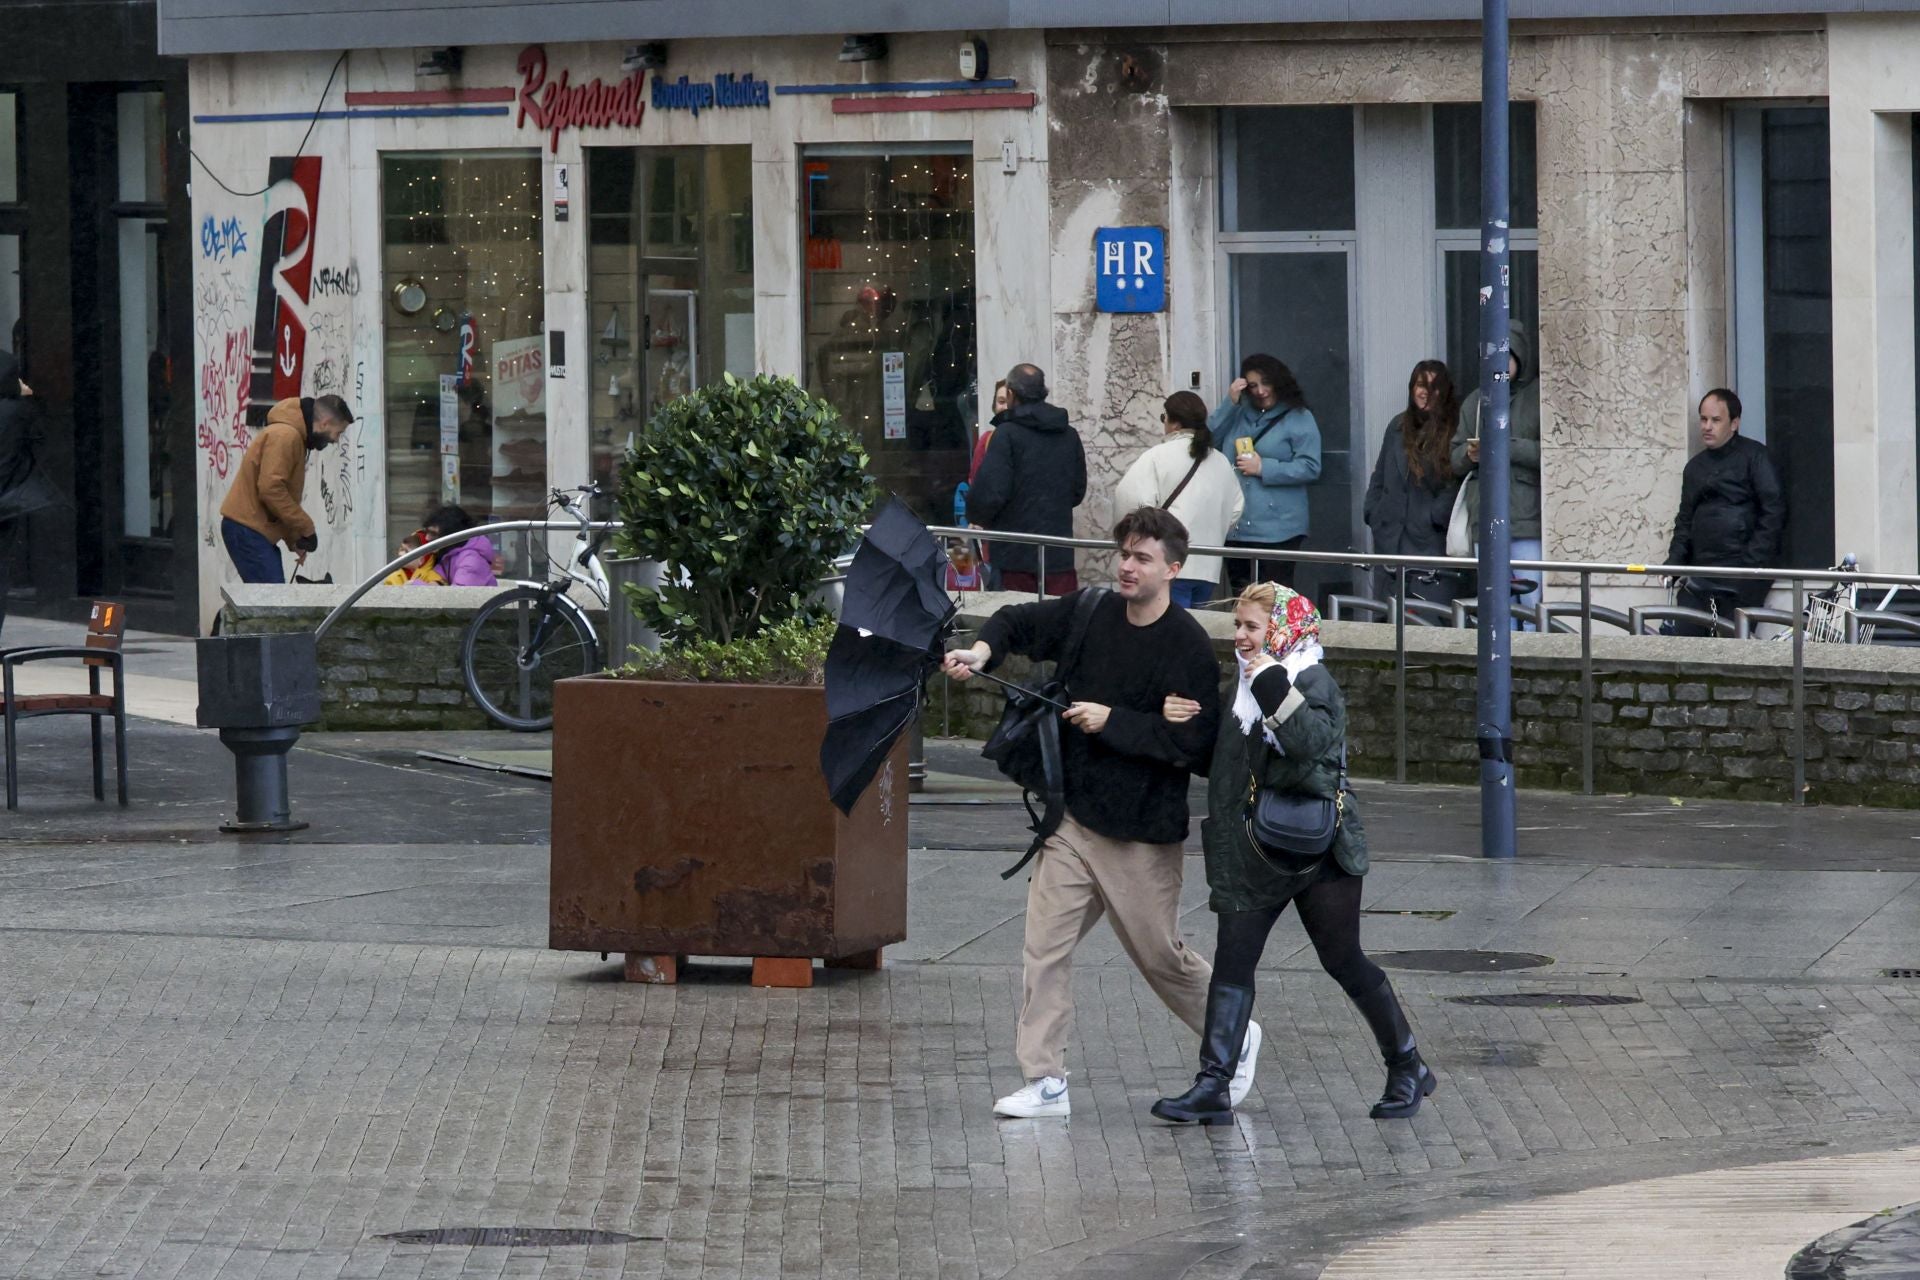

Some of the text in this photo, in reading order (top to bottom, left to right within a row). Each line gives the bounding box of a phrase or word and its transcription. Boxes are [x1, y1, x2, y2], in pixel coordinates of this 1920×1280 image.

[516, 45, 645, 154] Repnaval
[651, 75, 713, 118] Boutique
[498, 350, 542, 381] PITAS
